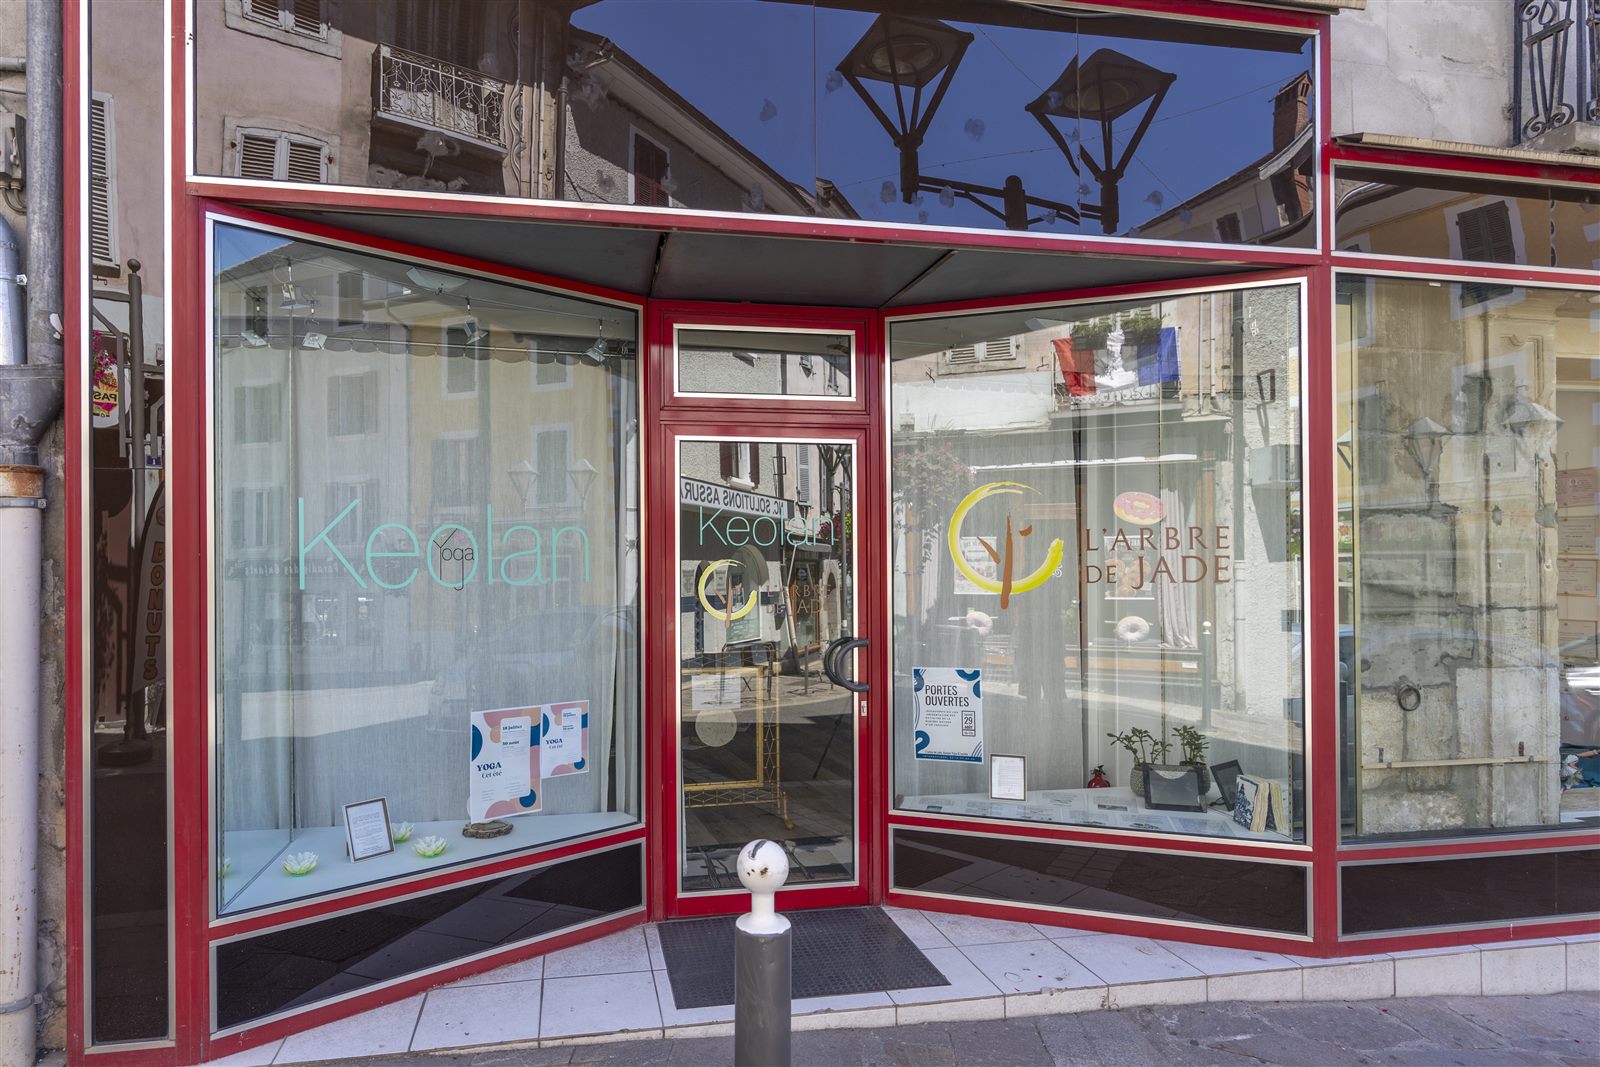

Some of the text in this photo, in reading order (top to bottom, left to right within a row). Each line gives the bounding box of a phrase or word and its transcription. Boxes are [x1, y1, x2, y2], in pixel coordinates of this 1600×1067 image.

[699, 506, 836, 546] Keolan
[298, 497, 590, 590] Keolan
[1085, 526, 1231, 551] L'ARBRE
[433, 528, 475, 591] Yoga
[1085, 555, 1231, 590] DE JADE
[766, 584, 832, 598] L'RBRE
[143, 541, 165, 680] DONUTS
[925, 685, 958, 696] PORTES
[925, 695, 970, 707] OUVERTES
[964, 716, 973, 725] 29
[476, 762, 502, 772] YOGA
[481, 770, 502, 779] Cet été
